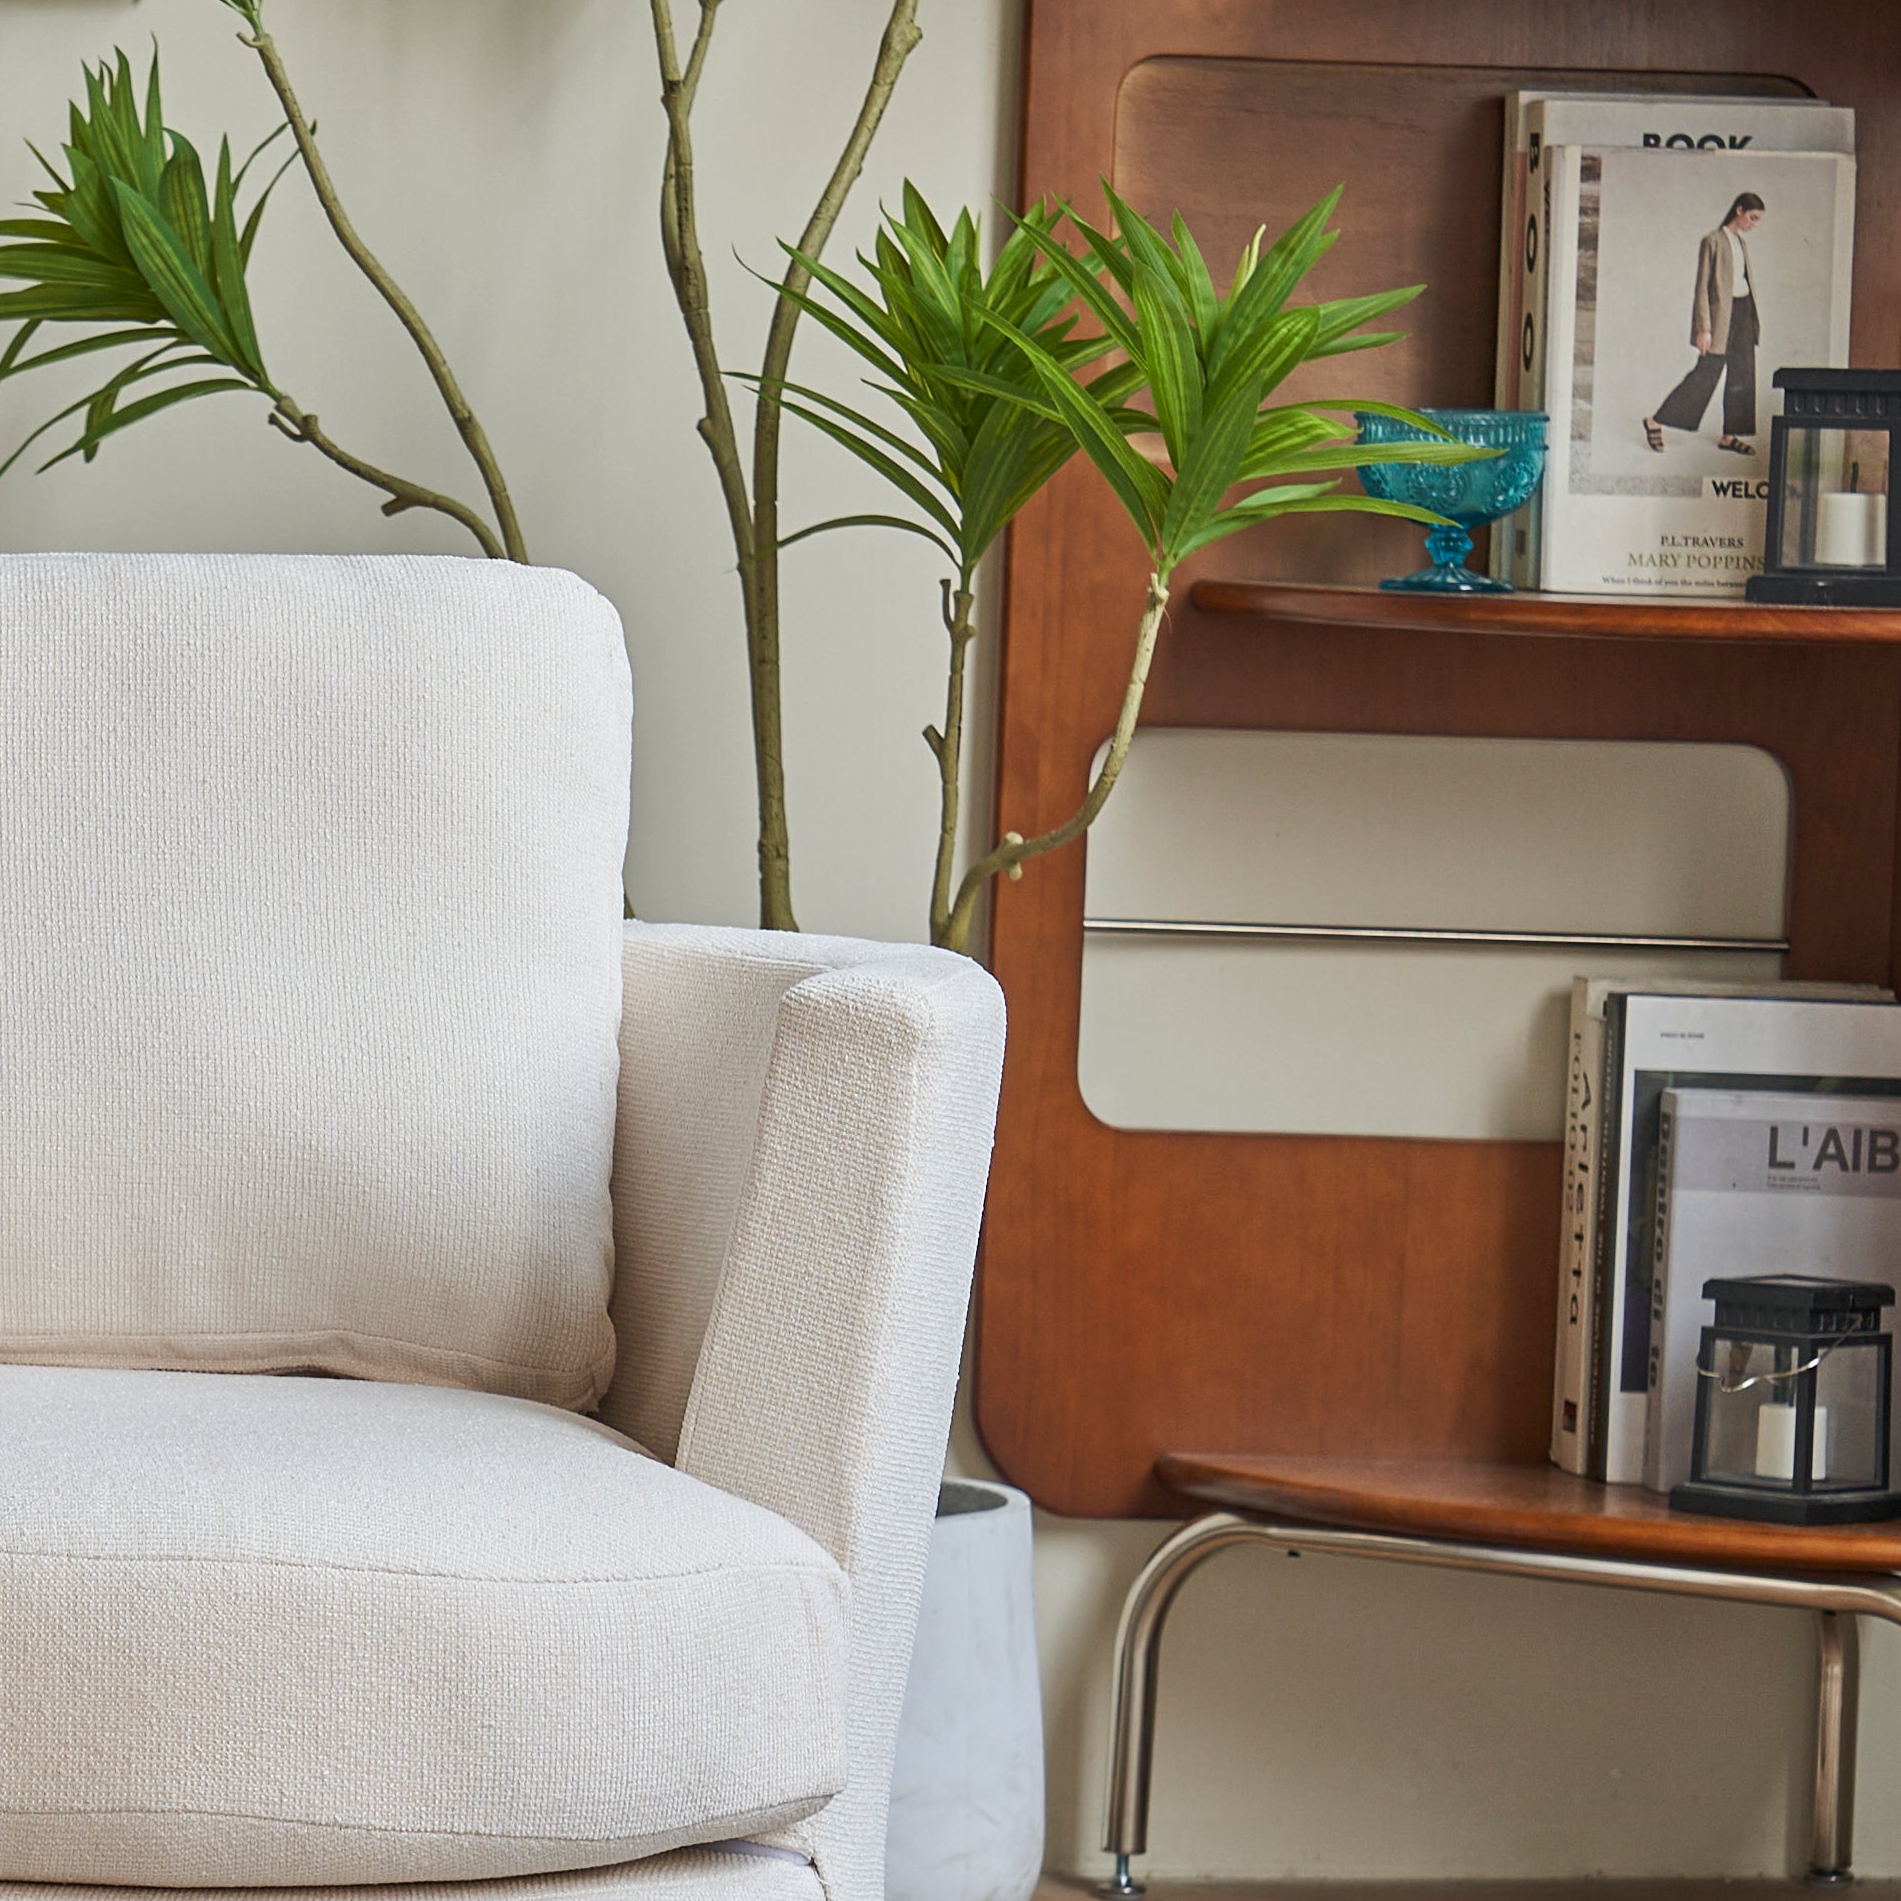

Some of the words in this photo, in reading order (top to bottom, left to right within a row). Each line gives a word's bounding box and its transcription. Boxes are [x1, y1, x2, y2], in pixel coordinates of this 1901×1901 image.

[1627, 553, 1680, 568] MARY
[1687, 555, 1765, 570] POPPINS
[1570, 1071, 1592, 1325] Arletta
[1655, 1113, 1671, 1263] Dentro
[1652, 1279, 1663, 1321] di
